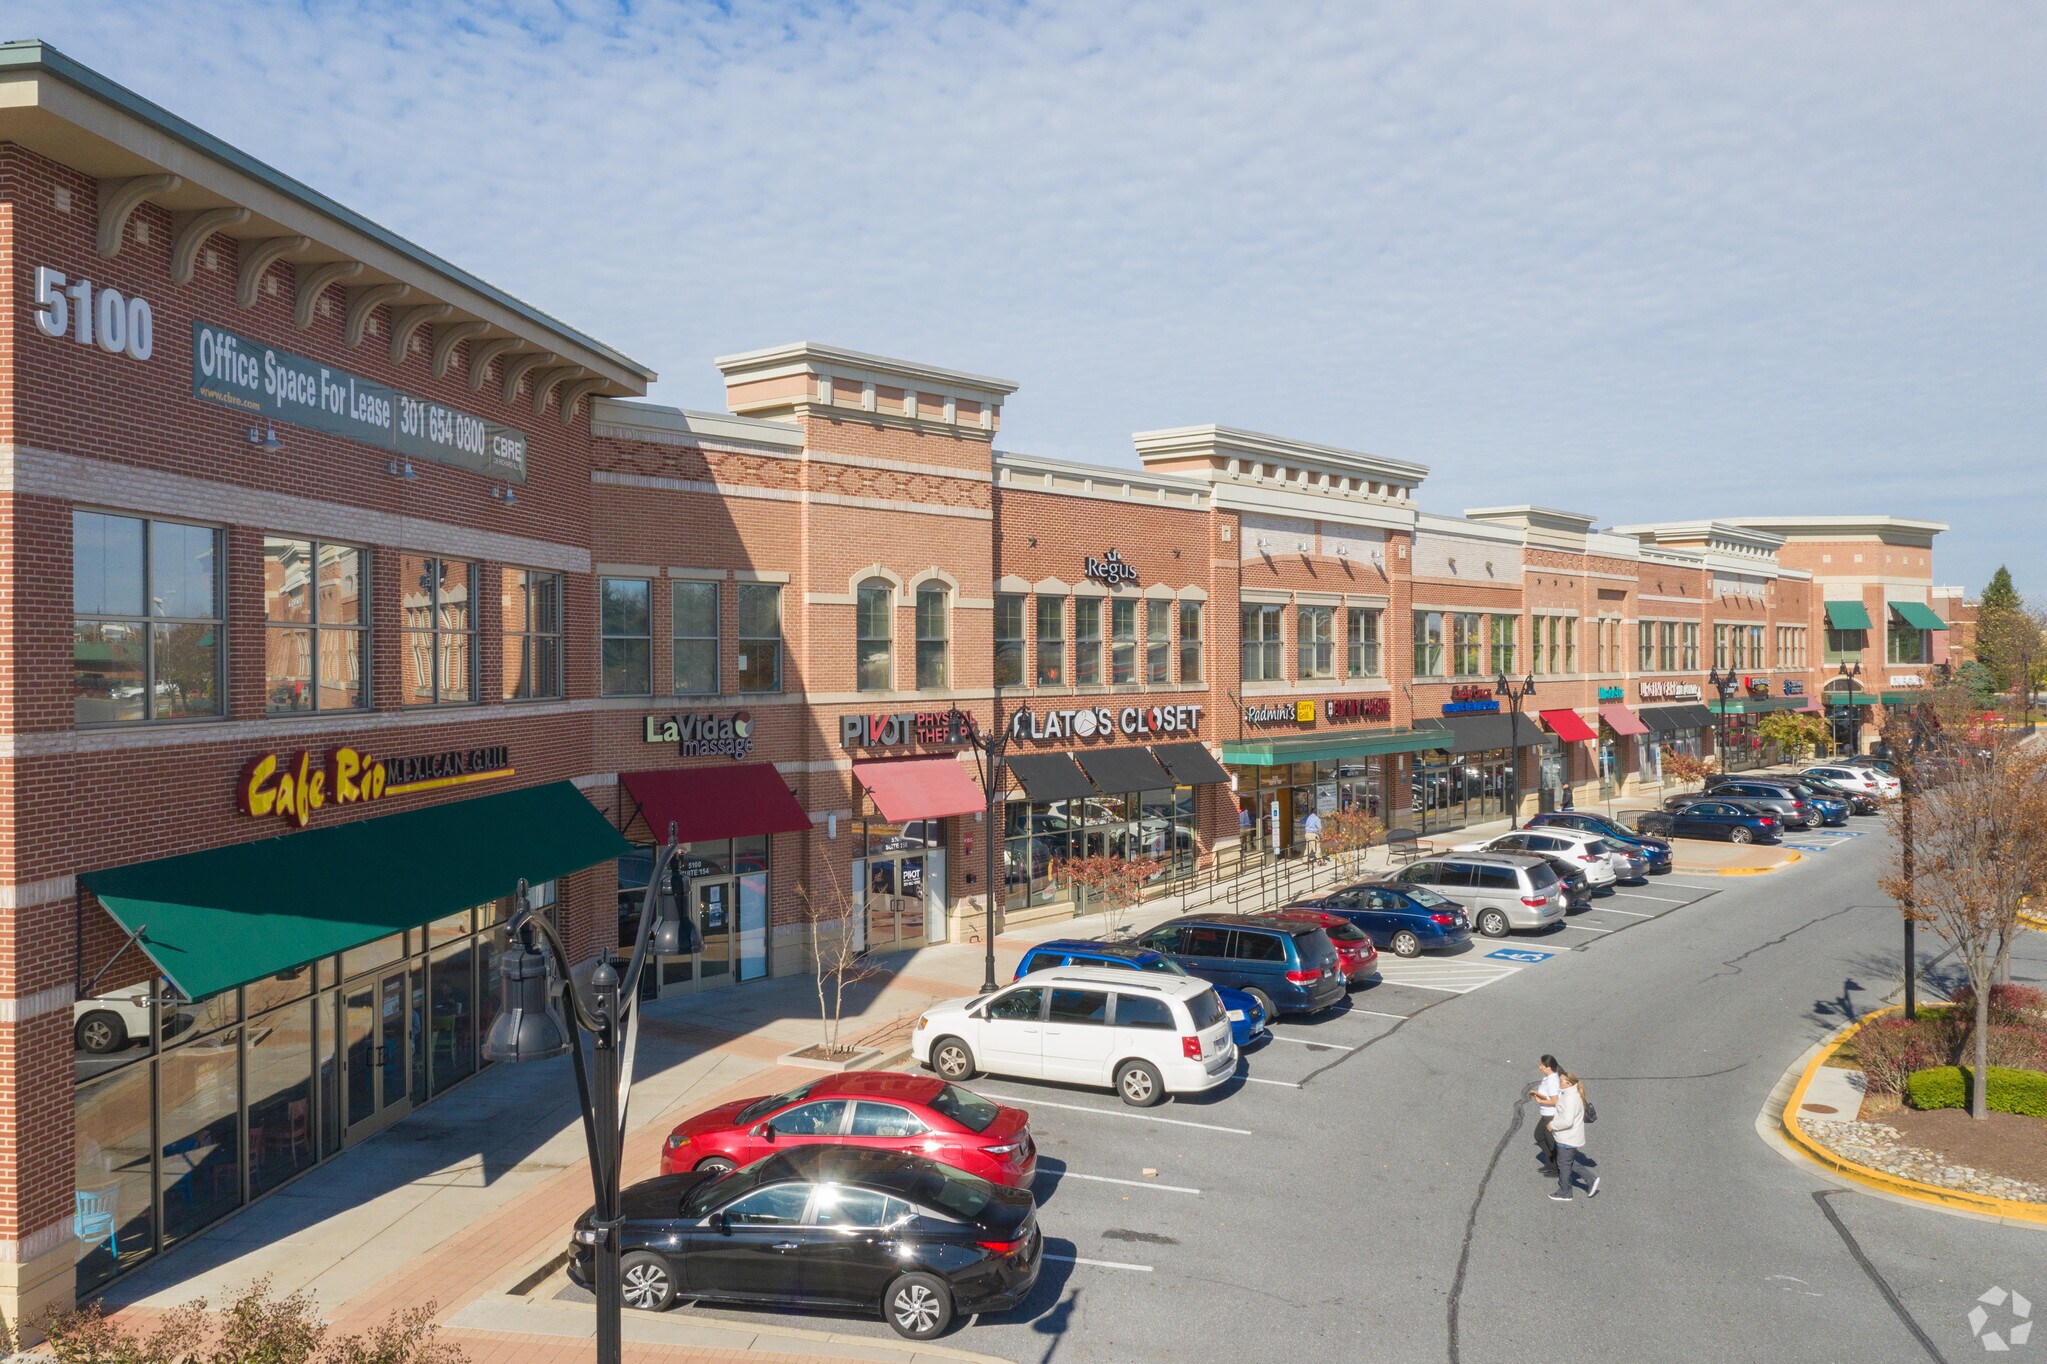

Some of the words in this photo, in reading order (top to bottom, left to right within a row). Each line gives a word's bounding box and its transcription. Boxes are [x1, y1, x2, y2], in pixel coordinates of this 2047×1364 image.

[34, 266, 153, 360] 5100
[200, 328, 259, 389] Office
[264, 350, 316, 408] Space
[321, 368, 346, 415] For
[350, 378, 390, 429] Lease
[400, 396, 424, 438] 301
[429, 405, 453, 446] 654
[456, 414, 485, 456] 0800
[200, 386, 260, 411] www.cbre.com
[493, 435, 522, 462] CBRE
[1088, 557, 1137, 583] Regus
[647, 715, 734, 742] LaVida
[842, 714, 916, 748] PIVOT
[917, 710, 976, 726] PHYSAL
[1121, 705, 1201, 734] CLOSET
[918, 727, 975, 743] THERP
[682, 738, 754, 760] massage
[388, 754, 464, 786] MEXICAN
